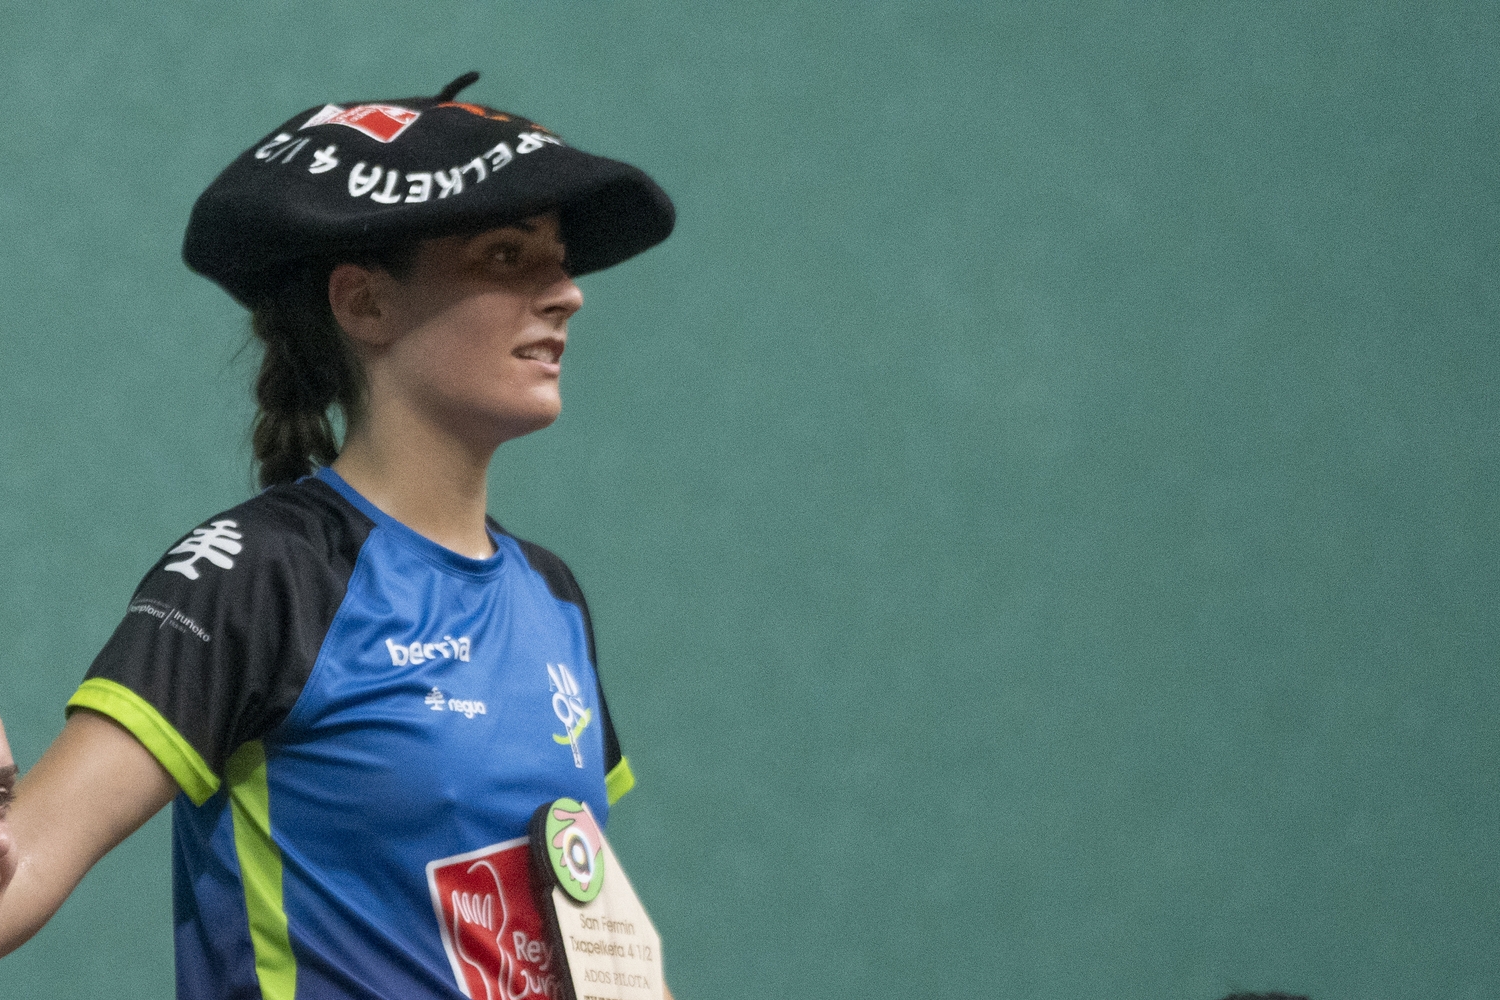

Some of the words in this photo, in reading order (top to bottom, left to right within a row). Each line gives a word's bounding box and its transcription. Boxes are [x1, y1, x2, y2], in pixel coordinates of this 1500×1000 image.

[253, 133, 311, 165] 1/2
[308, 144, 340, 175] 4
[348, 130, 562, 204] PELKETA
[386, 635, 472, 668] berria
[447, 696, 487, 718] negua
[580, 914, 599, 930] San
[512, 930, 553, 972] Rey
[569, 936, 625, 958] Txapelketa
[627, 944, 635, 958] 4
[636, 944, 653, 961] 1/2
[584, 969, 612, 984] ADOS
[614, 972, 650, 989] PILOTA
